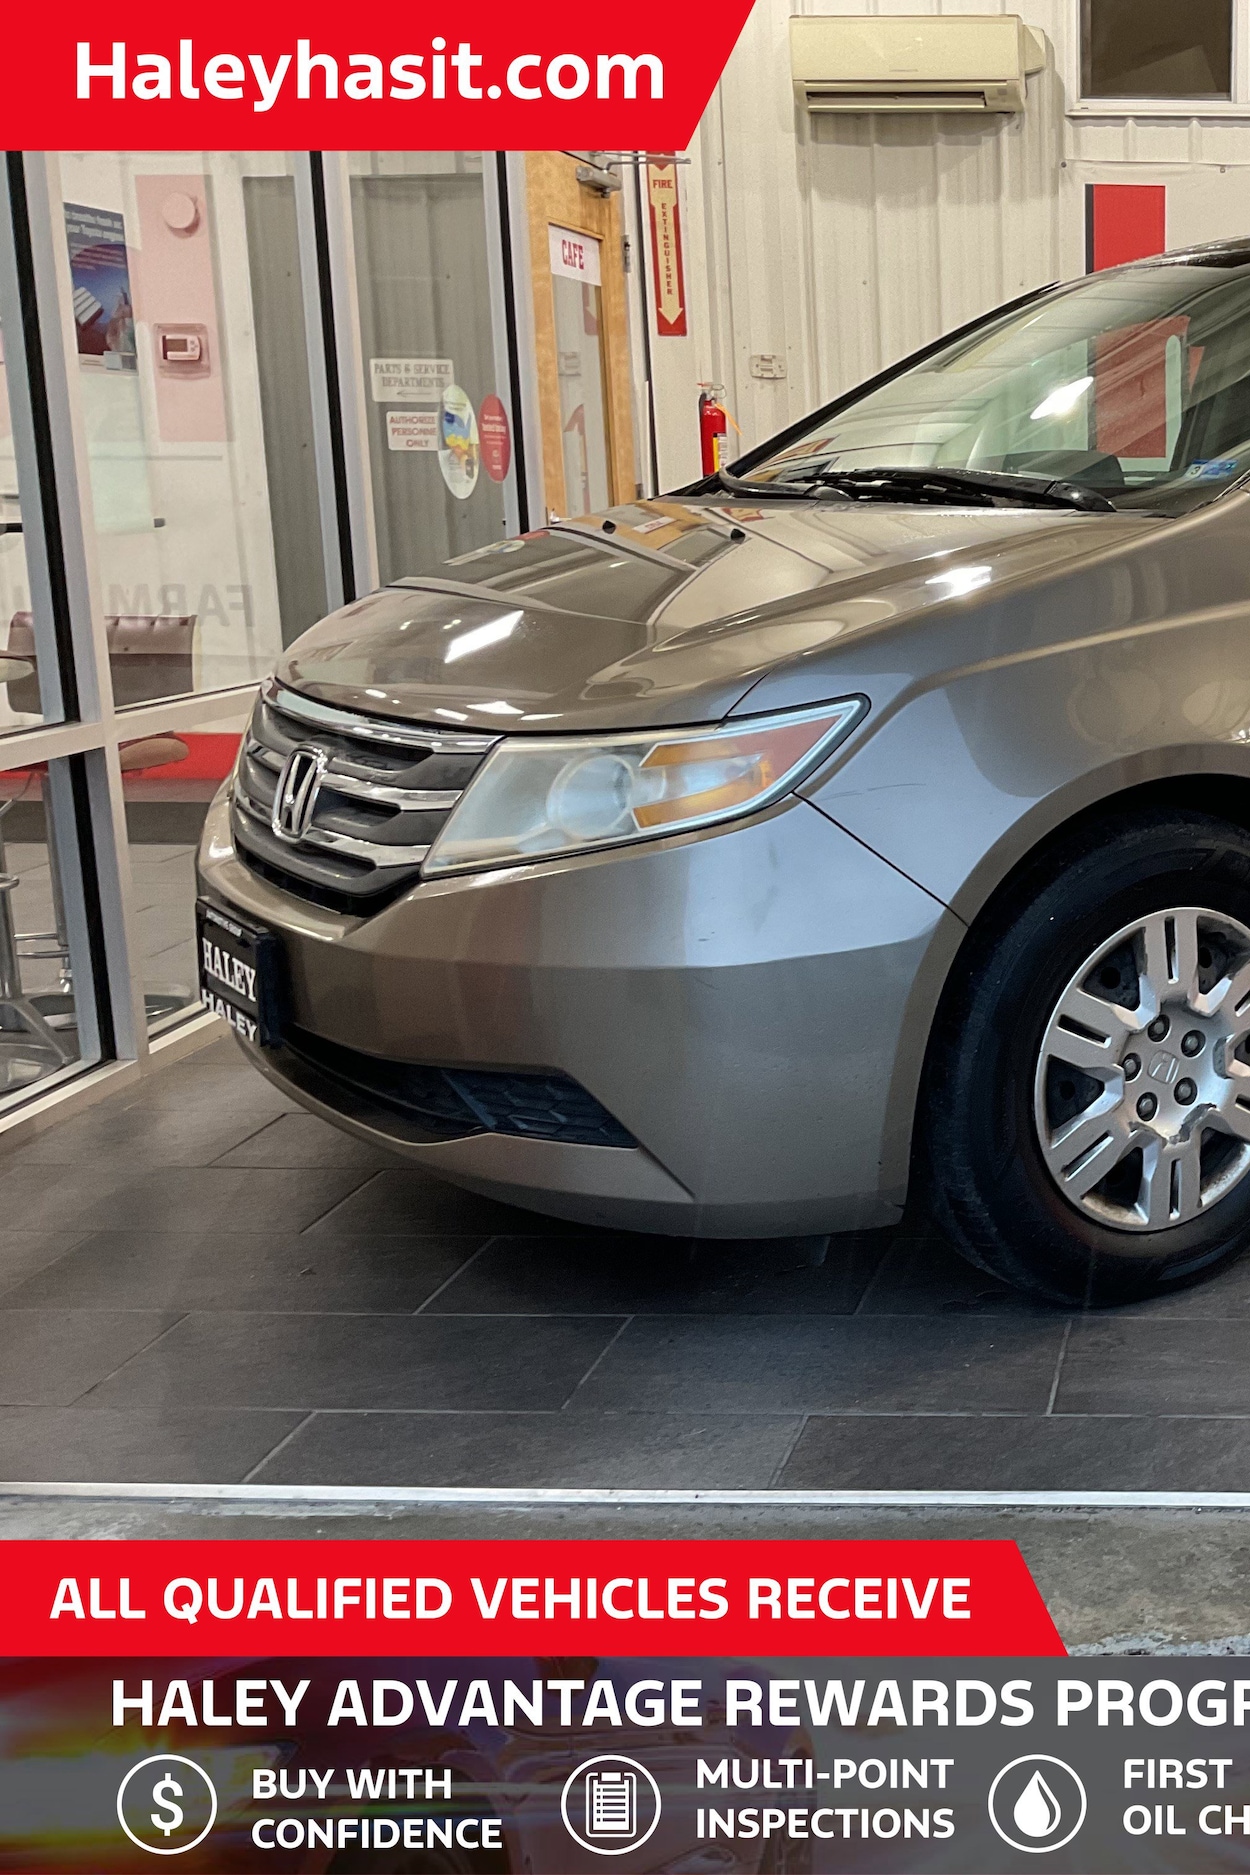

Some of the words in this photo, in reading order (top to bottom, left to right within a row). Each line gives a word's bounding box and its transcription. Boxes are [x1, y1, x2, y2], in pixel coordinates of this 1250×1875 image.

[653, 179, 673, 189] FIRE
[561, 239, 585, 270] CAFE
[661, 203, 673, 295] EXTINGUISHER
[374, 363, 402, 375] PARTS
[404, 364, 411, 375] &
[413, 364, 450, 375] SERVICE
[382, 376, 444, 388] DEPARTMENTS
[389, 415, 436, 424] AUTHORIZE
[391, 427, 437, 436] PERSONNE
[405, 439, 429, 447] ONLY
[202, 937, 256, 1002] HALEY
[201, 988, 257, 1041] HALEY
